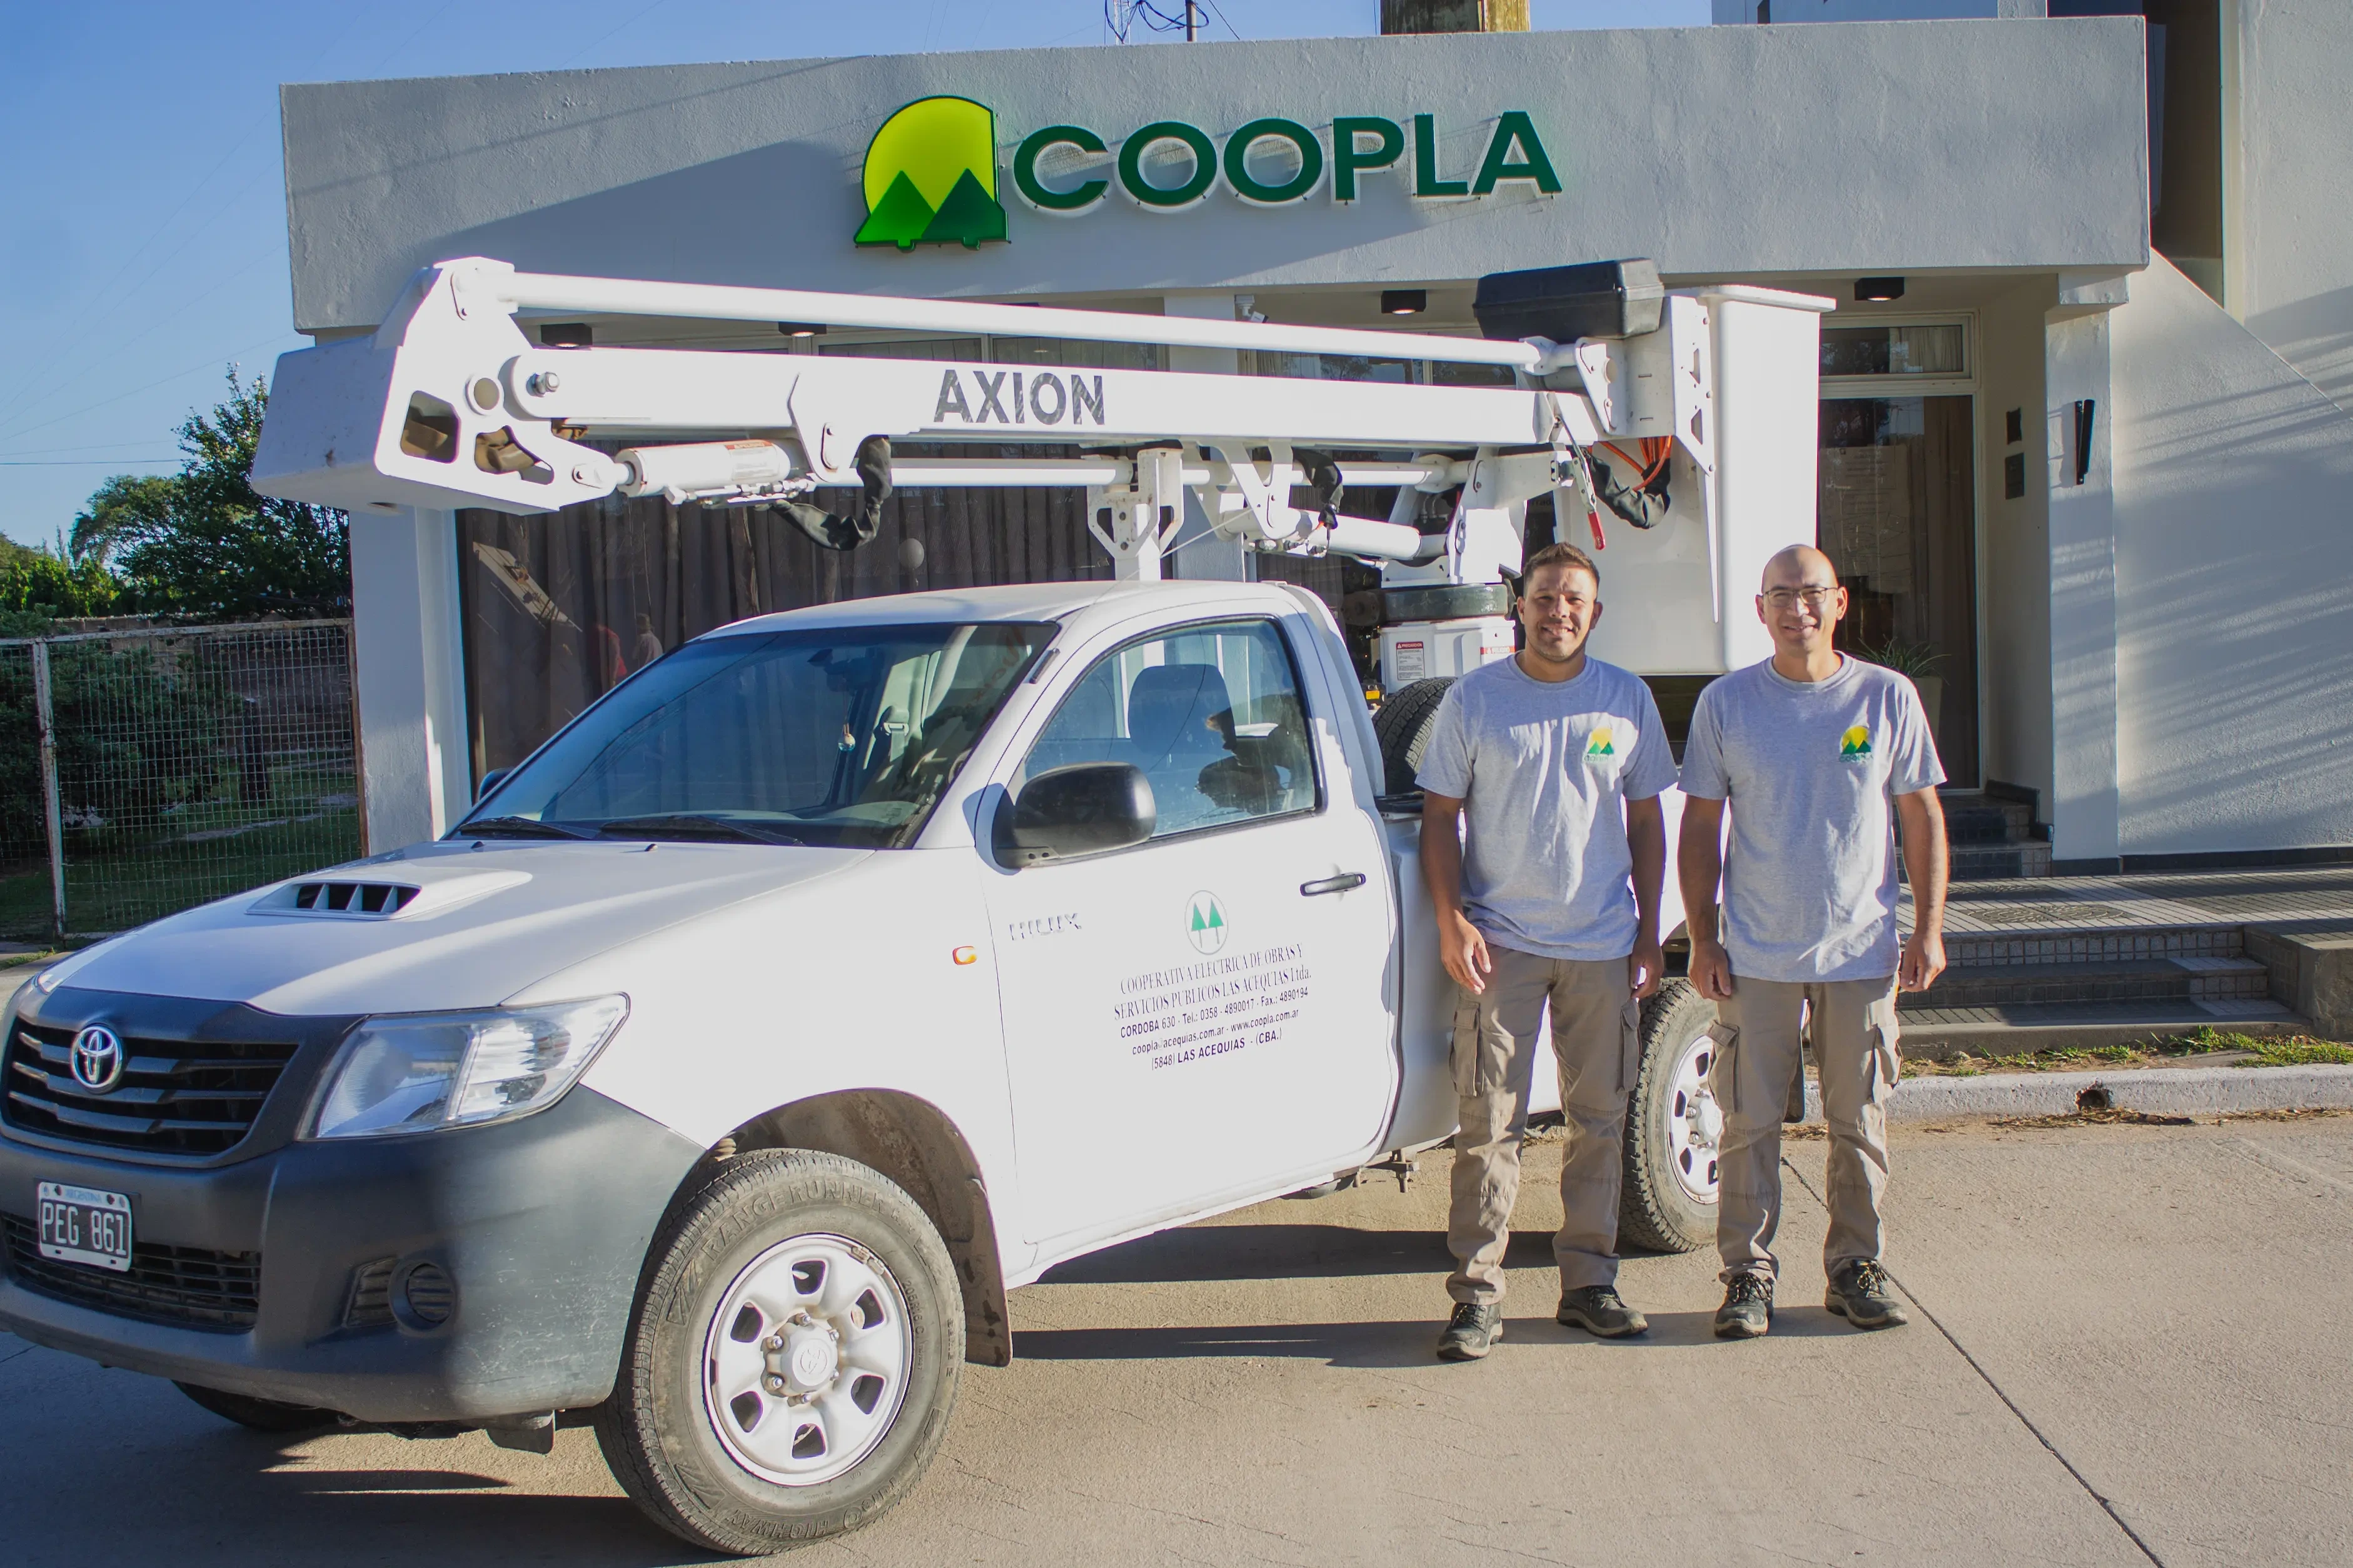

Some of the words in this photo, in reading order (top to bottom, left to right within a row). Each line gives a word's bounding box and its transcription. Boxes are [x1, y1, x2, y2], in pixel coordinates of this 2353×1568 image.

[1013, 111, 1564, 209] COOPLA
[934, 369, 1105, 426] AXION
[1114, 994, 1169, 1020] SERVICIOS
[1172, 985, 1219, 1008] PUBLICOS
[1222, 979, 1240, 997] LAS
[1242, 968, 1289, 992] ACEQUIAS
[1291, 965, 1311, 982] Ltda.
[1121, 966, 1192, 994] COOPERATIVA
[1195, 955, 1248, 979] ELECTRICA
[1250, 951, 1262, 968] DE
[1264, 945, 1296, 964] OBRAS
[1297, 943, 1302, 958] Y
[1121, 1020, 1159, 1038] CORDOBA
[1162, 1016, 1176, 1029] 630
[1201, 1007, 1217, 1020] 0358
[1224, 998, 1254, 1015] 4890017
[1279, 986, 1308, 1002] 4890194
[1132, 1026, 1224, 1055] cooplaacequias.com.ar
[1231, 1009, 1299, 1032] www.coopla.com.ar
[1151, 1053, 1176, 1070] (5848)
[1177, 1049, 1196, 1063] LAS
[1198, 1037, 1245, 1058] ACEQUIAS
[1256, 1027, 1282, 1045] (CBA.)
[41, 1202, 79, 1246] PEG
[91, 1210, 127, 1256] 861
[700, 1191, 787, 1261] RANGE
[789, 1179, 885, 1216] RUNNER
[725, 1509, 830, 1539] HIGHWAY
